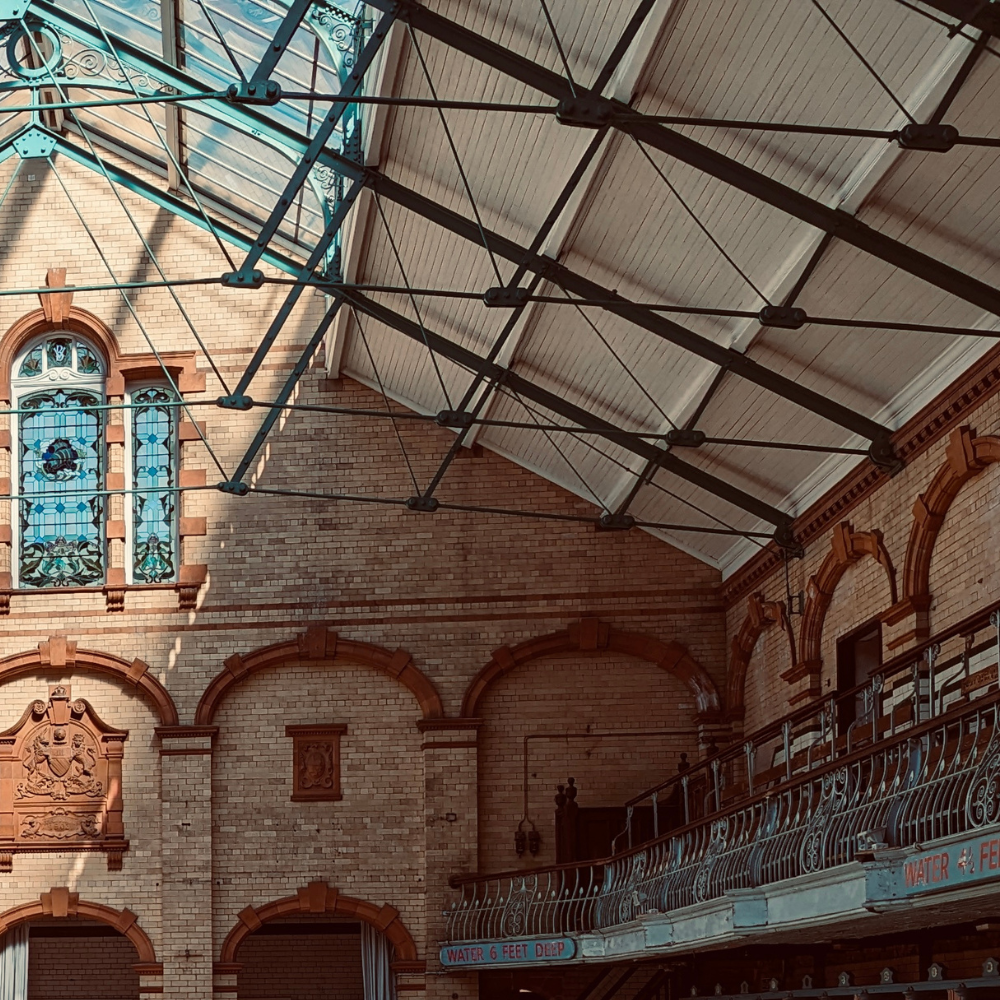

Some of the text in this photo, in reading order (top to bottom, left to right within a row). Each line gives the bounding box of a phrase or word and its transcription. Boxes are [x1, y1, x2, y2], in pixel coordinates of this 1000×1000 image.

[904, 853, 948, 888] WATER
[447, 941, 565, 963] WATER 6 FEET DEEP
